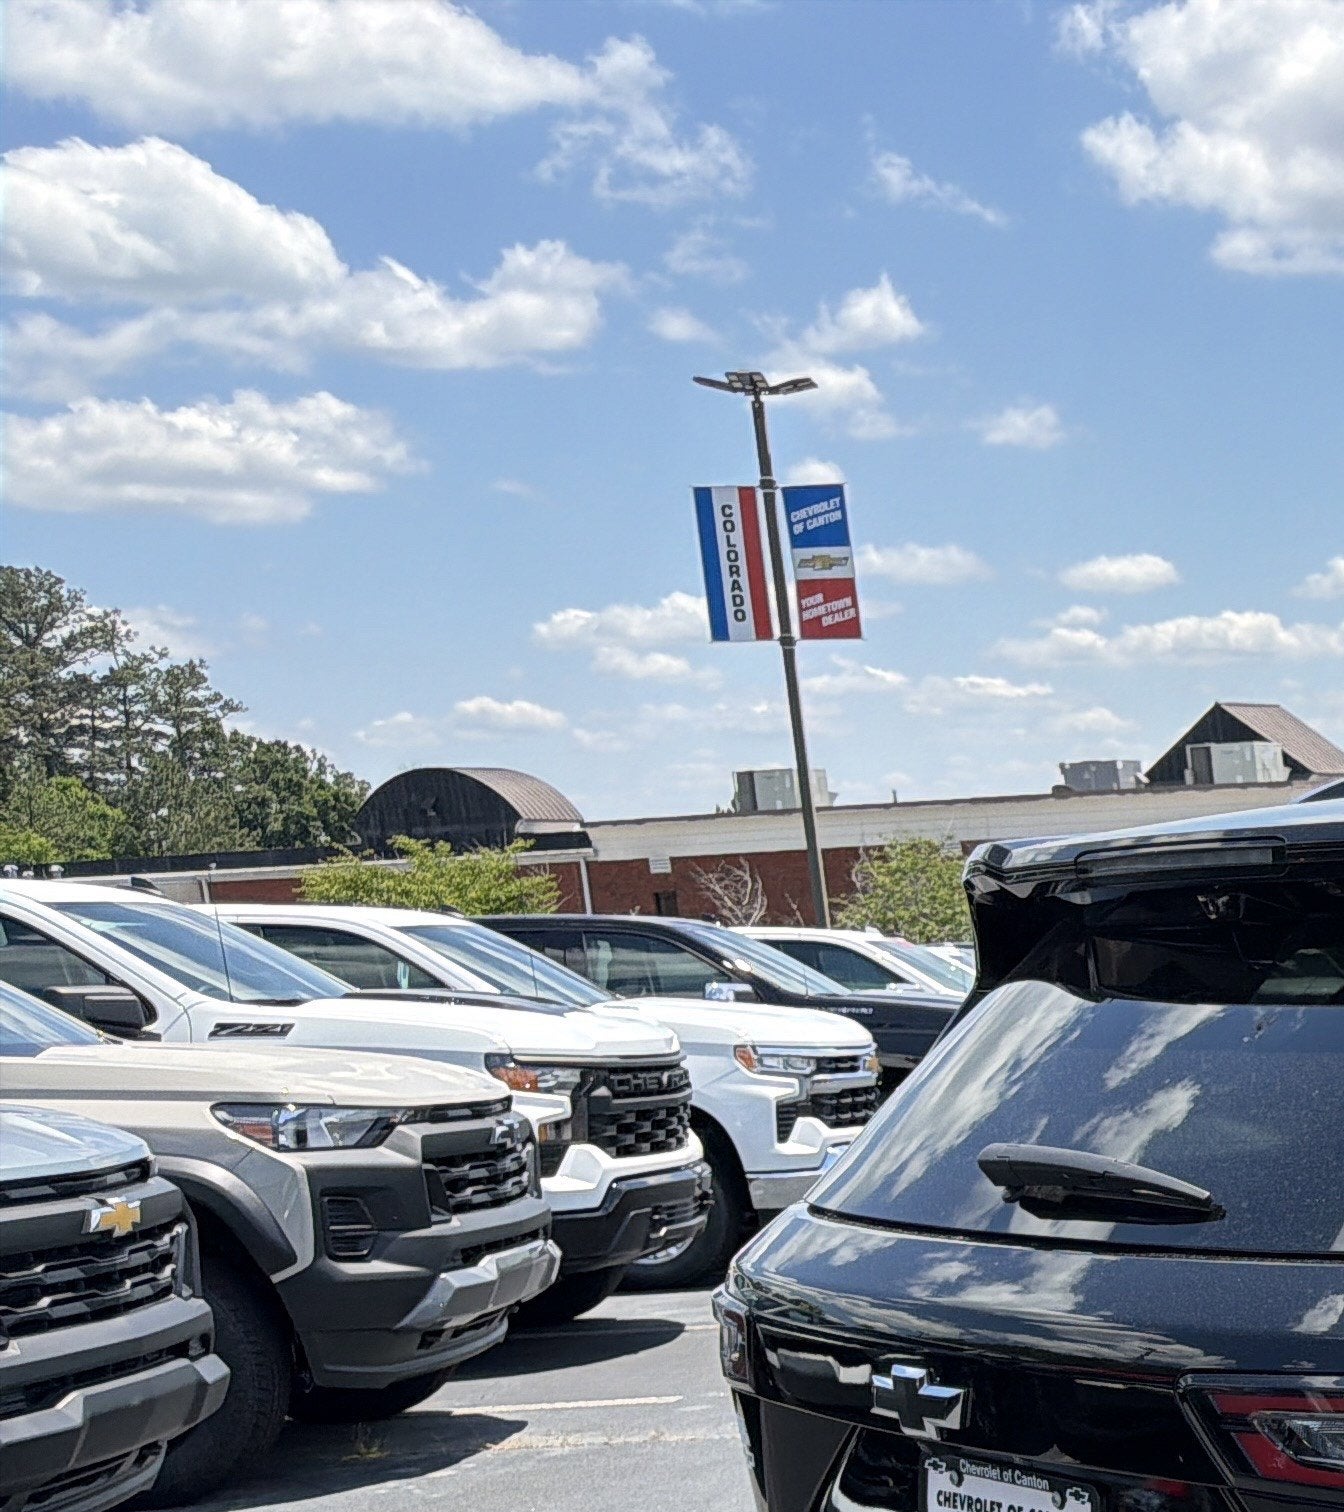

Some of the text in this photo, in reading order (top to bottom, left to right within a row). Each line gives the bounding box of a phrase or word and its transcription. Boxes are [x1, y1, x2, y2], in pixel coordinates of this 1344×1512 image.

[790, 496, 841, 523] CHEVROLET
[793, 523, 805, 536] OF
[720, 504, 747, 623] COLORADO
[801, 593, 824, 608] YOUR
[822, 608, 857, 628] DEALER
[959, 1458, 1050, 1491] Chevrolet of Canton
